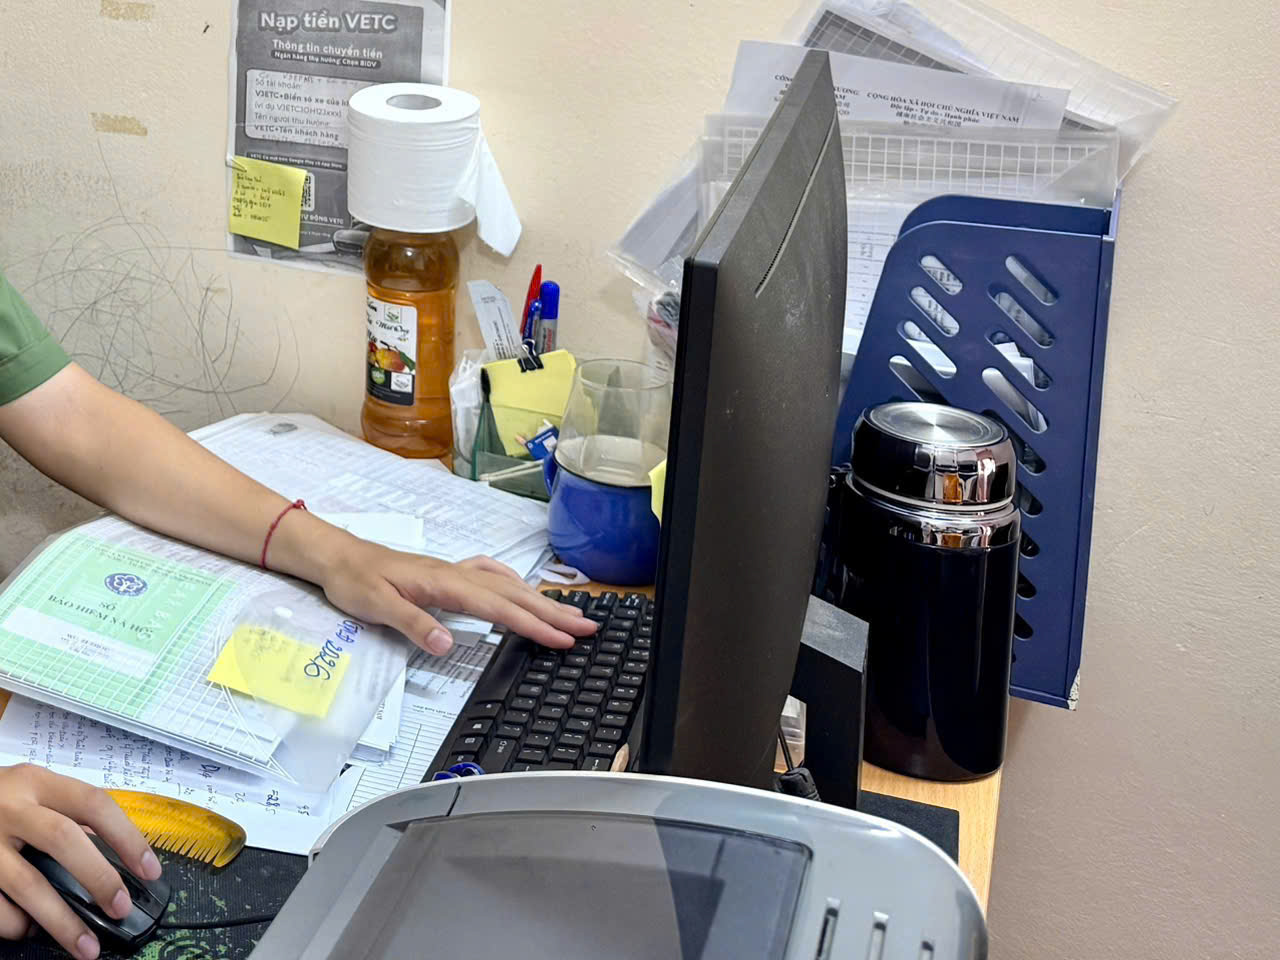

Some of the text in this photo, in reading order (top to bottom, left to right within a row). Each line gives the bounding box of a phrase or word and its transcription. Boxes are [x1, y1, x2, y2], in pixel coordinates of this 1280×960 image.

[260, 10, 395, 31] Nạp tiền VETC
[307, 41, 320, 52] tin
[866, 92, 1020, 123] CỘNG HÒA XÃ HỘI CHỦ NGHĨA VIỆT NAM
[890, 102, 903, 110] Độc
[904, 104, 914, 113] lập
[920, 107, 929, 115] Tự
[944, 112, 962, 121] Hạnh
[963, 115, 980, 124] phúc
[48, 593, 74, 608] BẢO
